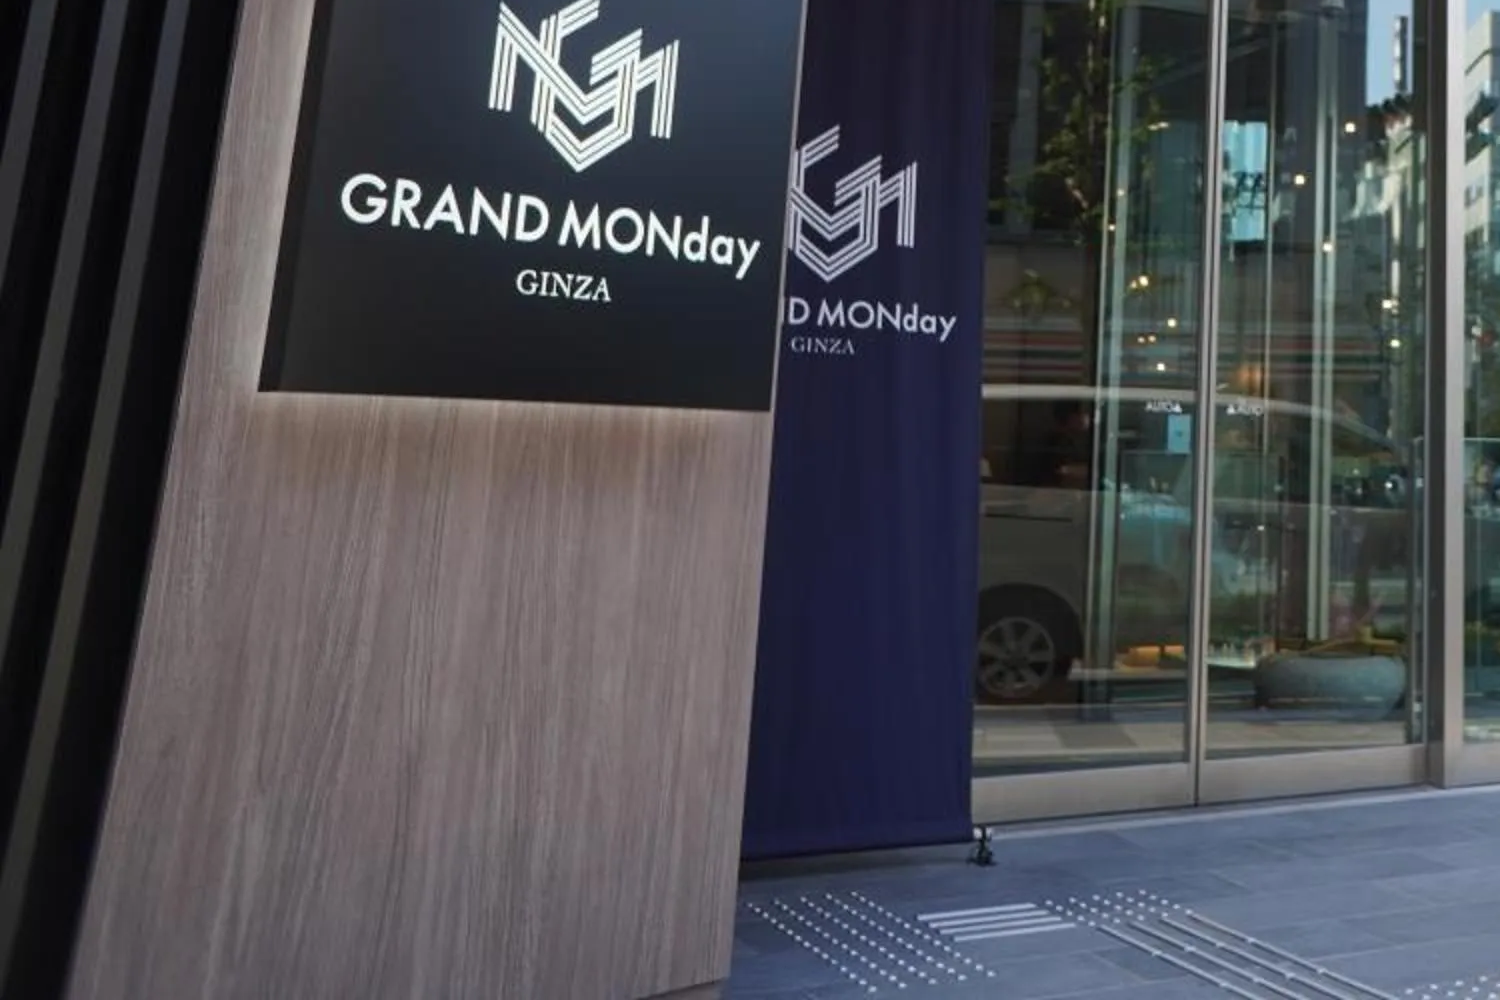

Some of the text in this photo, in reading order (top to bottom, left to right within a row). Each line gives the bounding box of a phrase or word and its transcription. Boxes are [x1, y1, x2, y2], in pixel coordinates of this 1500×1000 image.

[340, 172, 761, 280] GRAND MONday
[515, 268, 612, 302] GINZA
[816, 298, 957, 343] MONday
[790, 336, 856, 355] GINZA
